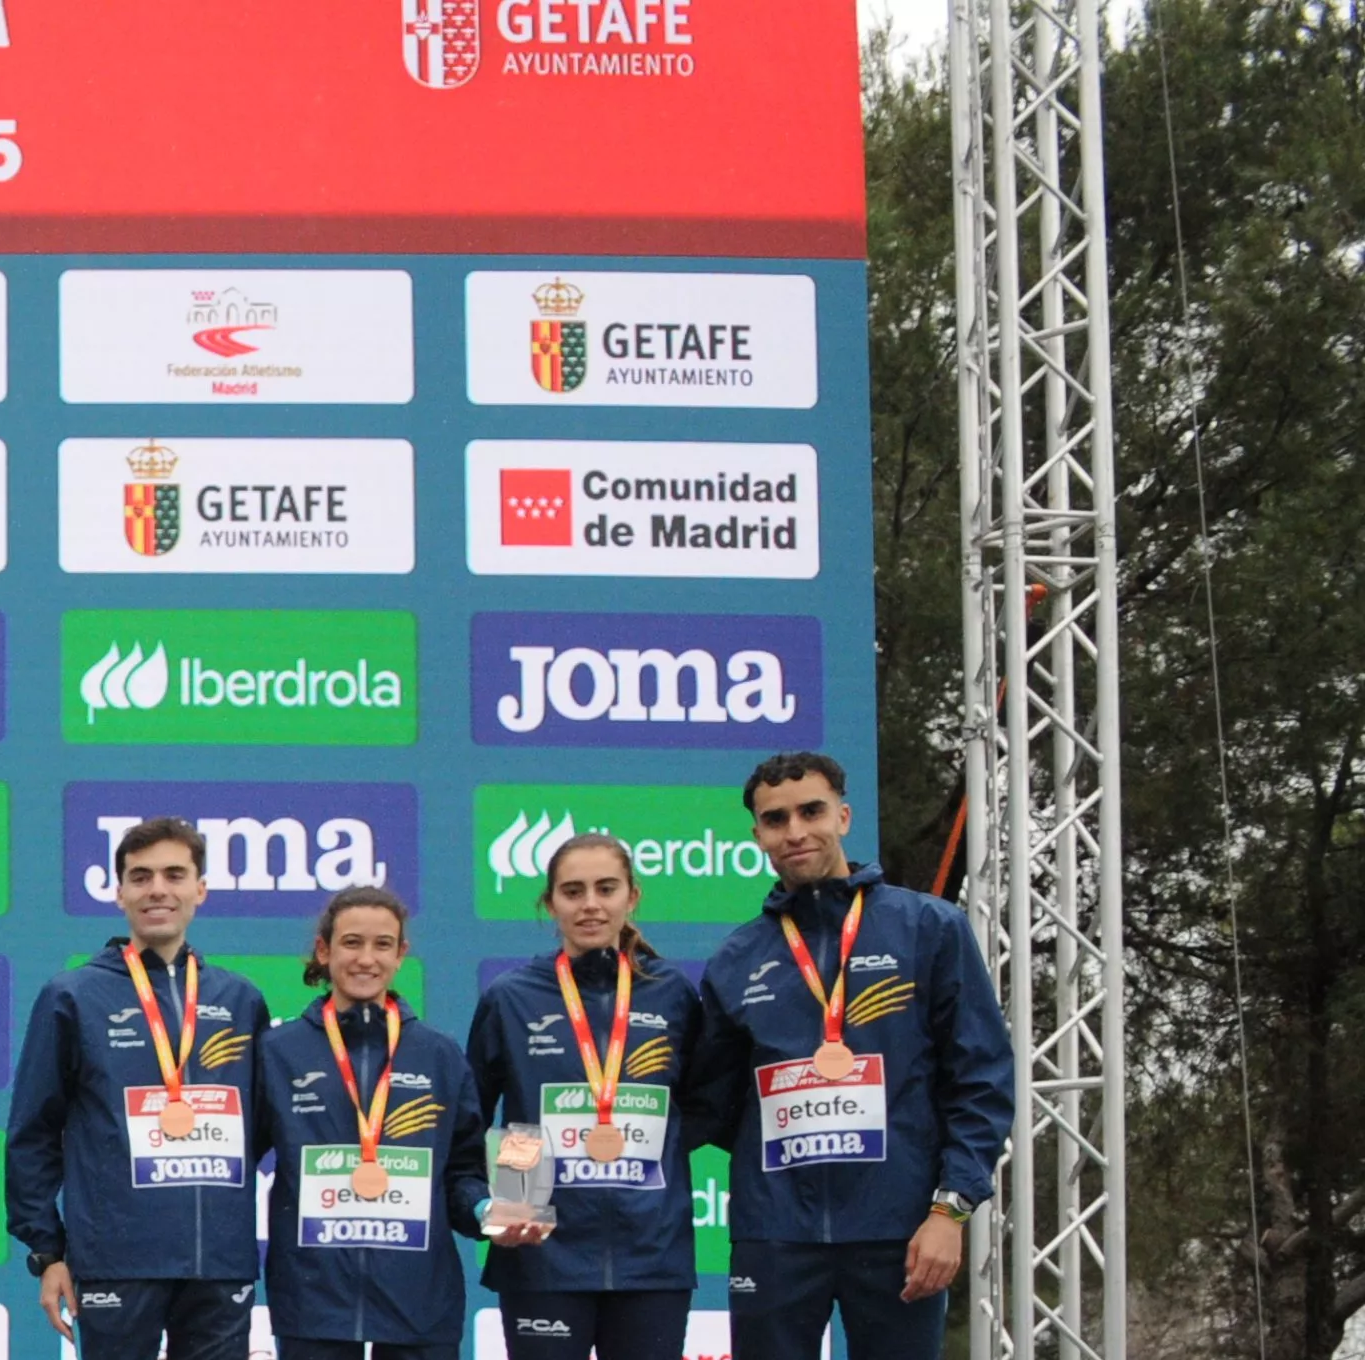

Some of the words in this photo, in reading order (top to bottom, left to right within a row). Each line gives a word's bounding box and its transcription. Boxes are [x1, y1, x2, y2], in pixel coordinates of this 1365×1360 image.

[496, 0, 693, 44] GETAFE
[502, 52, 694, 77] AYUNTAMIENTO
[602, 322, 753, 362] GETAFE
[212, 381, 258, 395] Madrid
[606, 365, 753, 389] AYUNTAMIENTO
[582, 471, 798, 504] Comunidad
[196, 485, 348, 523] GETAFE
[200, 528, 349, 550] AYUNTAMIENTO
[584, 517, 634, 549] de
[650, 516, 798, 551] Madrid
[179, 657, 401, 708] Iberdrola
[498, 645, 795, 733] Joma
[84, 816, 387, 902] Jma
[776, 1096, 865, 1128] getafe.
[781, 1132, 865, 1164] Joma
[150, 1157, 231, 1182] Joma
[559, 1158, 646, 1183] Joma
[317, 1219, 409, 1243] Joma
